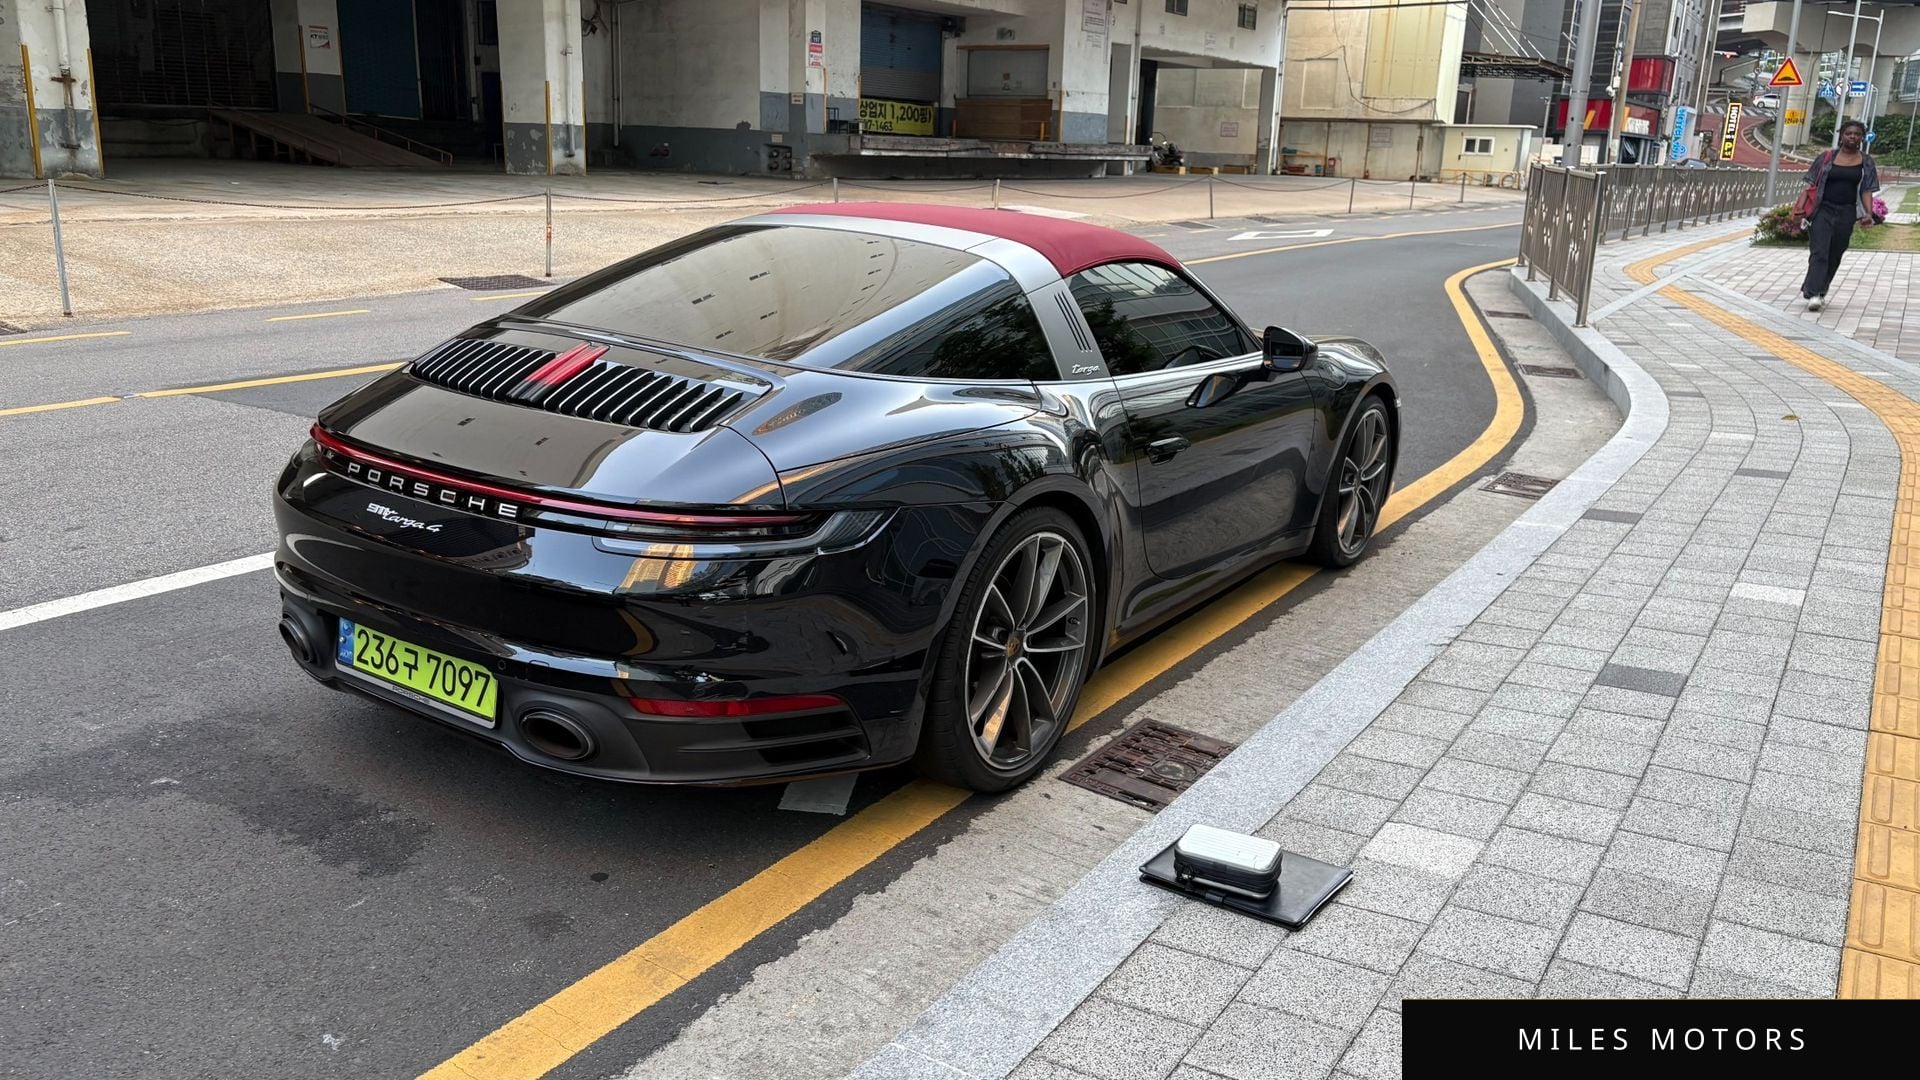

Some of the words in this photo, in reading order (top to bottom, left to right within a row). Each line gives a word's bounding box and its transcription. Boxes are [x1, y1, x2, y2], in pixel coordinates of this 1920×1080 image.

[347, 462, 518, 518] PORSCHE
[356, 629, 418, 680] 236구
[427, 653, 490, 707] 7097
